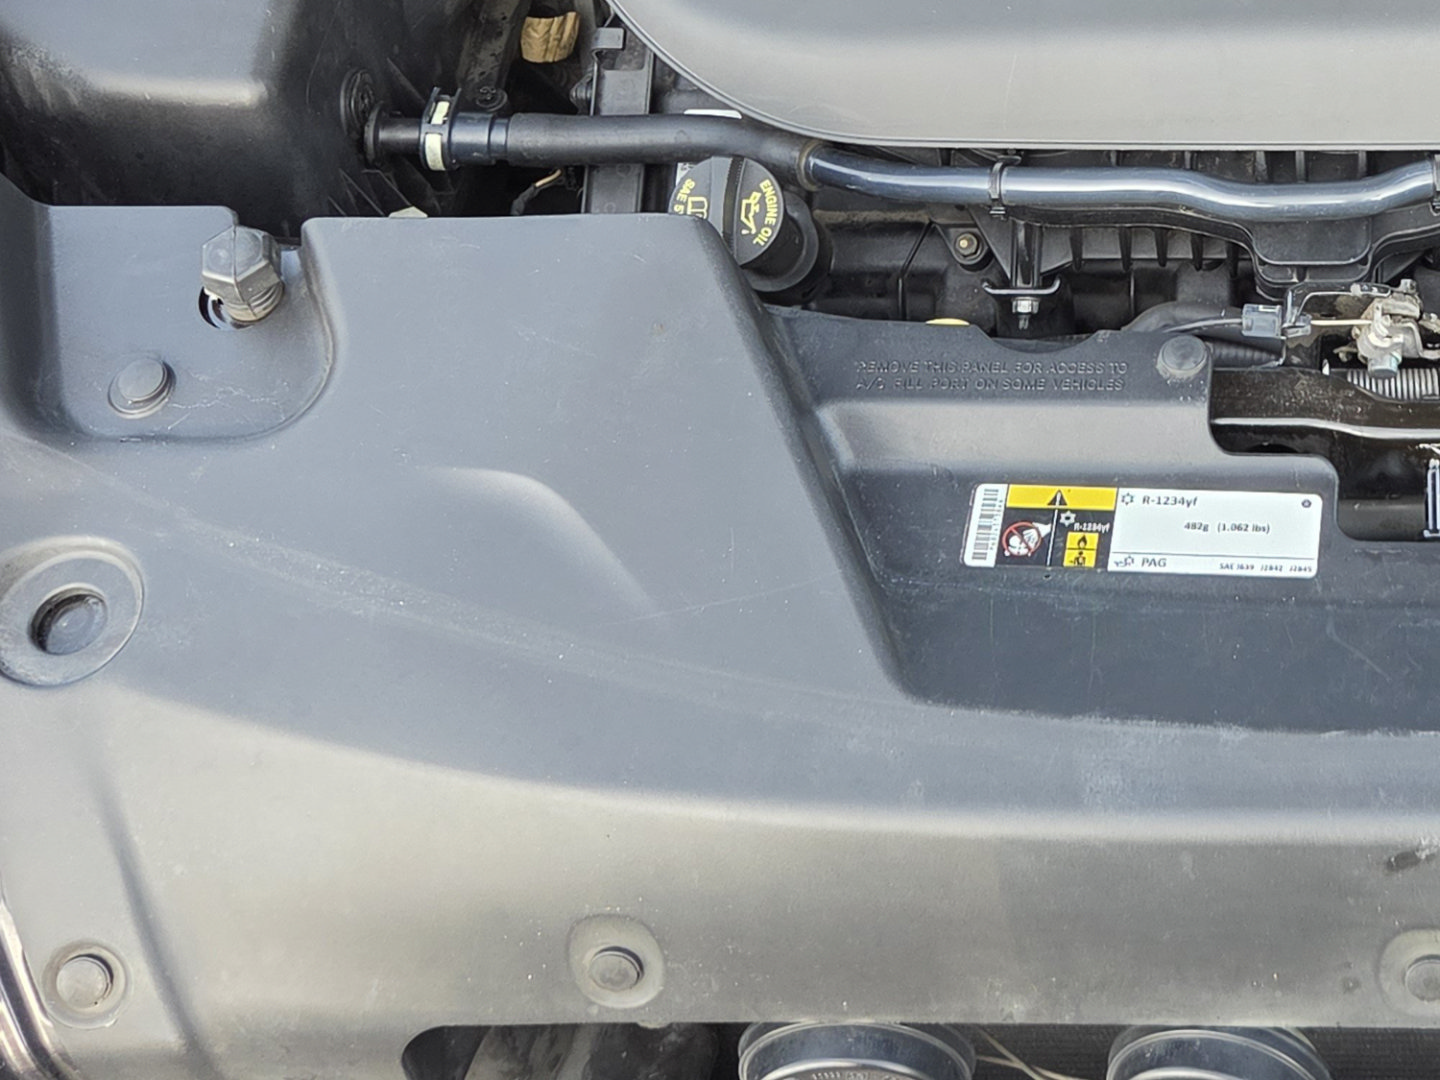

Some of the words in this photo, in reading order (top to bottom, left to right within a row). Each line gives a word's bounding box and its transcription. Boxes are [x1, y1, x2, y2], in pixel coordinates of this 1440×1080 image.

[676, 178, 696, 202] SAE
[760, 179, 778, 225] ENGINE
[753, 226, 772, 246] OIL
[854, 360, 920, 373] REMOVE
[923, 361, 958, 373] THIS
[961, 361, 1008, 373] PANEL
[1013, 361, 1043, 374] FOR
[1046, 361, 1105, 374] ACCESS
[1108, 361, 1128, 374] TO
[894, 377, 923, 391] FILL
[929, 377, 970, 391] PORT
[975, 377, 1000, 391] ON
[1001, 378, 1046, 391] SOME
[1052, 378, 1125, 391] VEHICLES
[1142, 494, 1198, 508] R-1234yf
[1183, 522, 1209, 533] 482g
[1218, 522, 1249, 533] (1.062
[1251, 522, 1270, 534] lbs)
[1141, 556, 1167, 568] PAG
